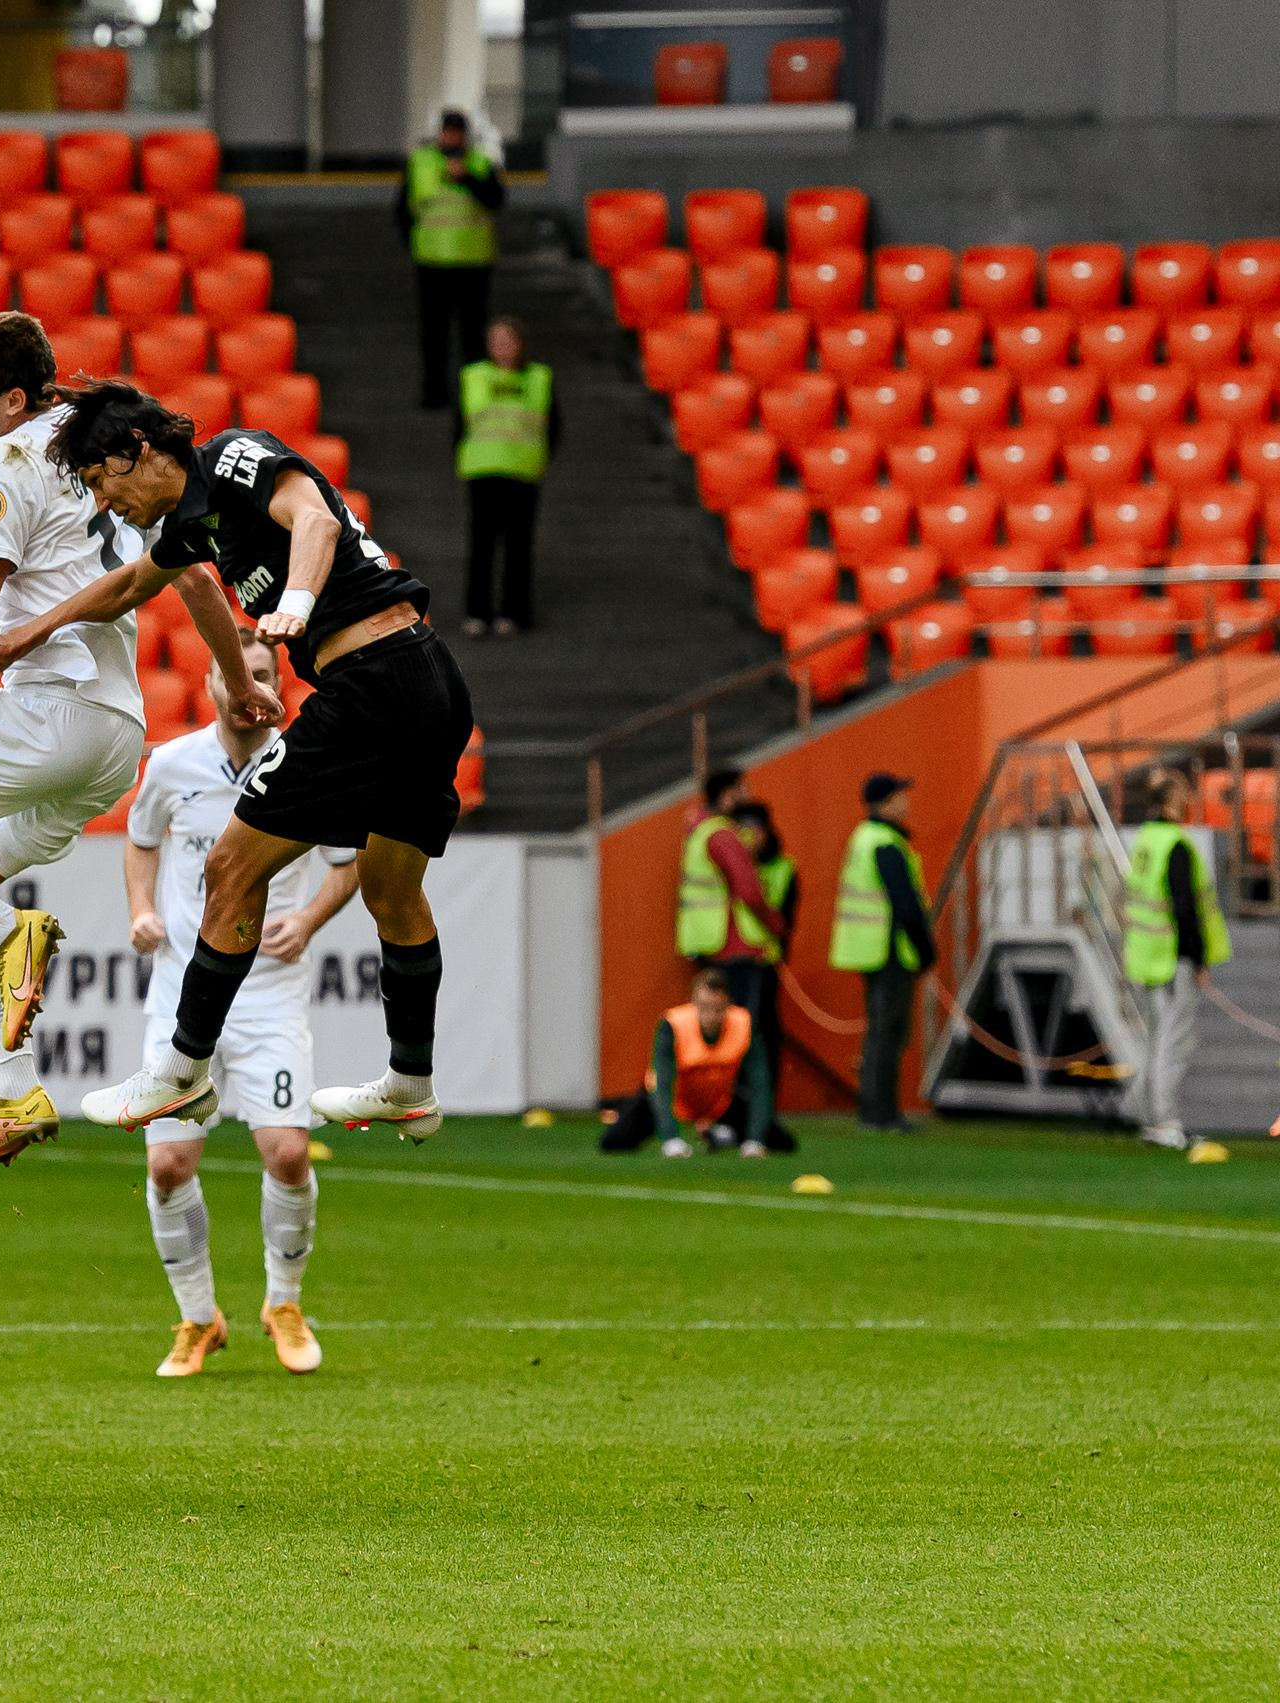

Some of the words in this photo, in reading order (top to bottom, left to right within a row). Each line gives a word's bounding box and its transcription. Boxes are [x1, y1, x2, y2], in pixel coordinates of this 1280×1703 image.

[233, 446, 277, 489] LAN
[244, 738, 286, 797] 2
[274, 1069, 292, 1108] 8
